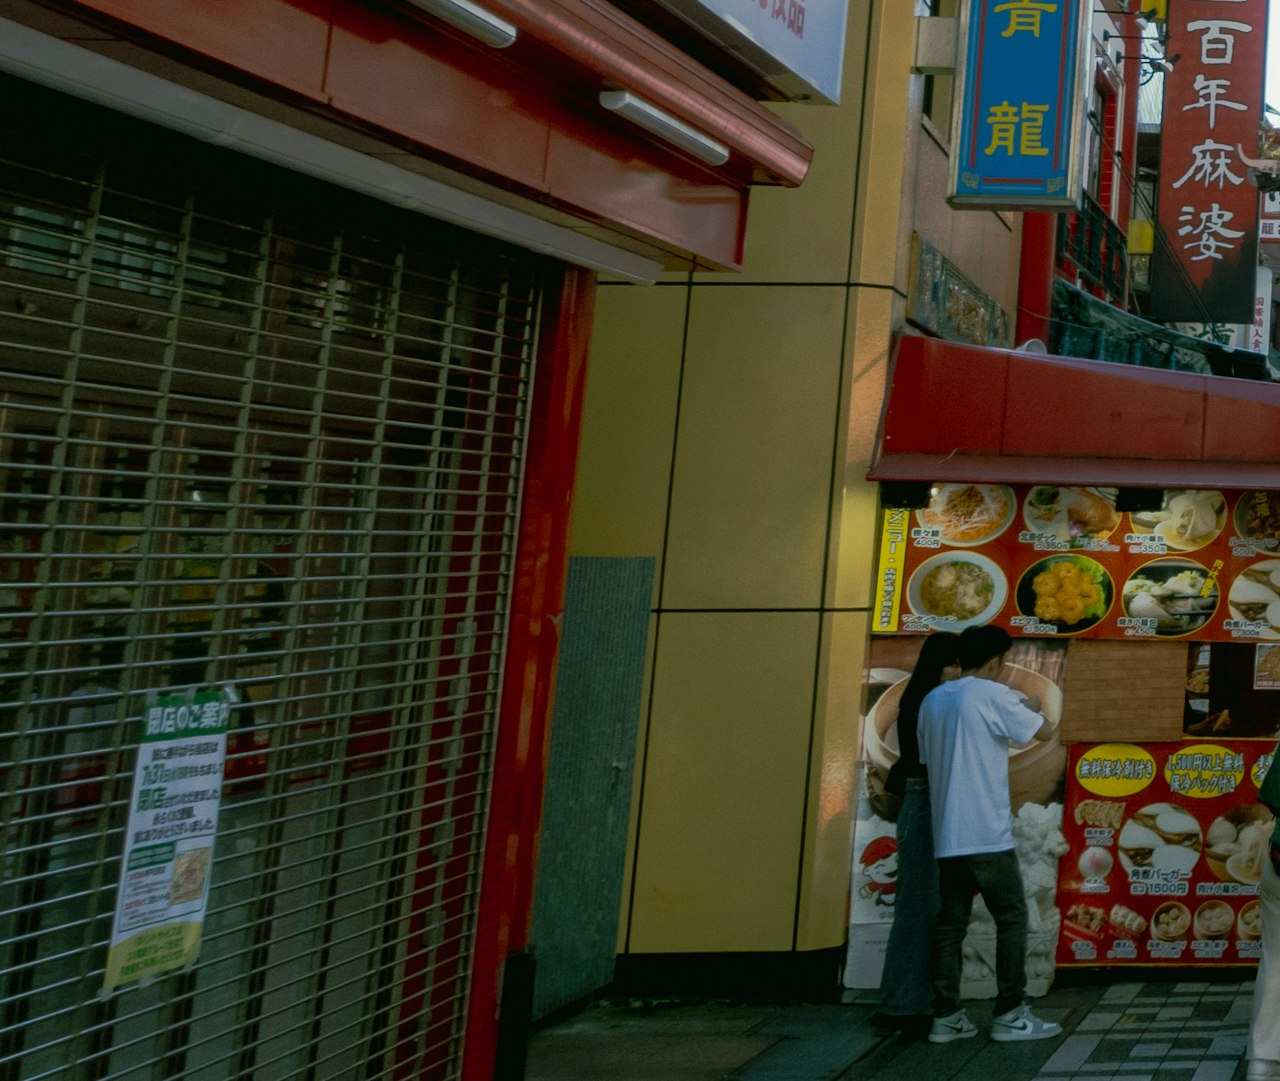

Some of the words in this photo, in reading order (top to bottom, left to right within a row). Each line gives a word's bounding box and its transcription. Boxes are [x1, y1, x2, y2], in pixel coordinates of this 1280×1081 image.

[1173, 19, 1249, 262] 百年麻婆
[1170, 773, 1236, 793] 保冷パック付き
[1131, 868, 1190, 881] 角煮バーガー
[1149, 883, 1187, 894] 1500円
